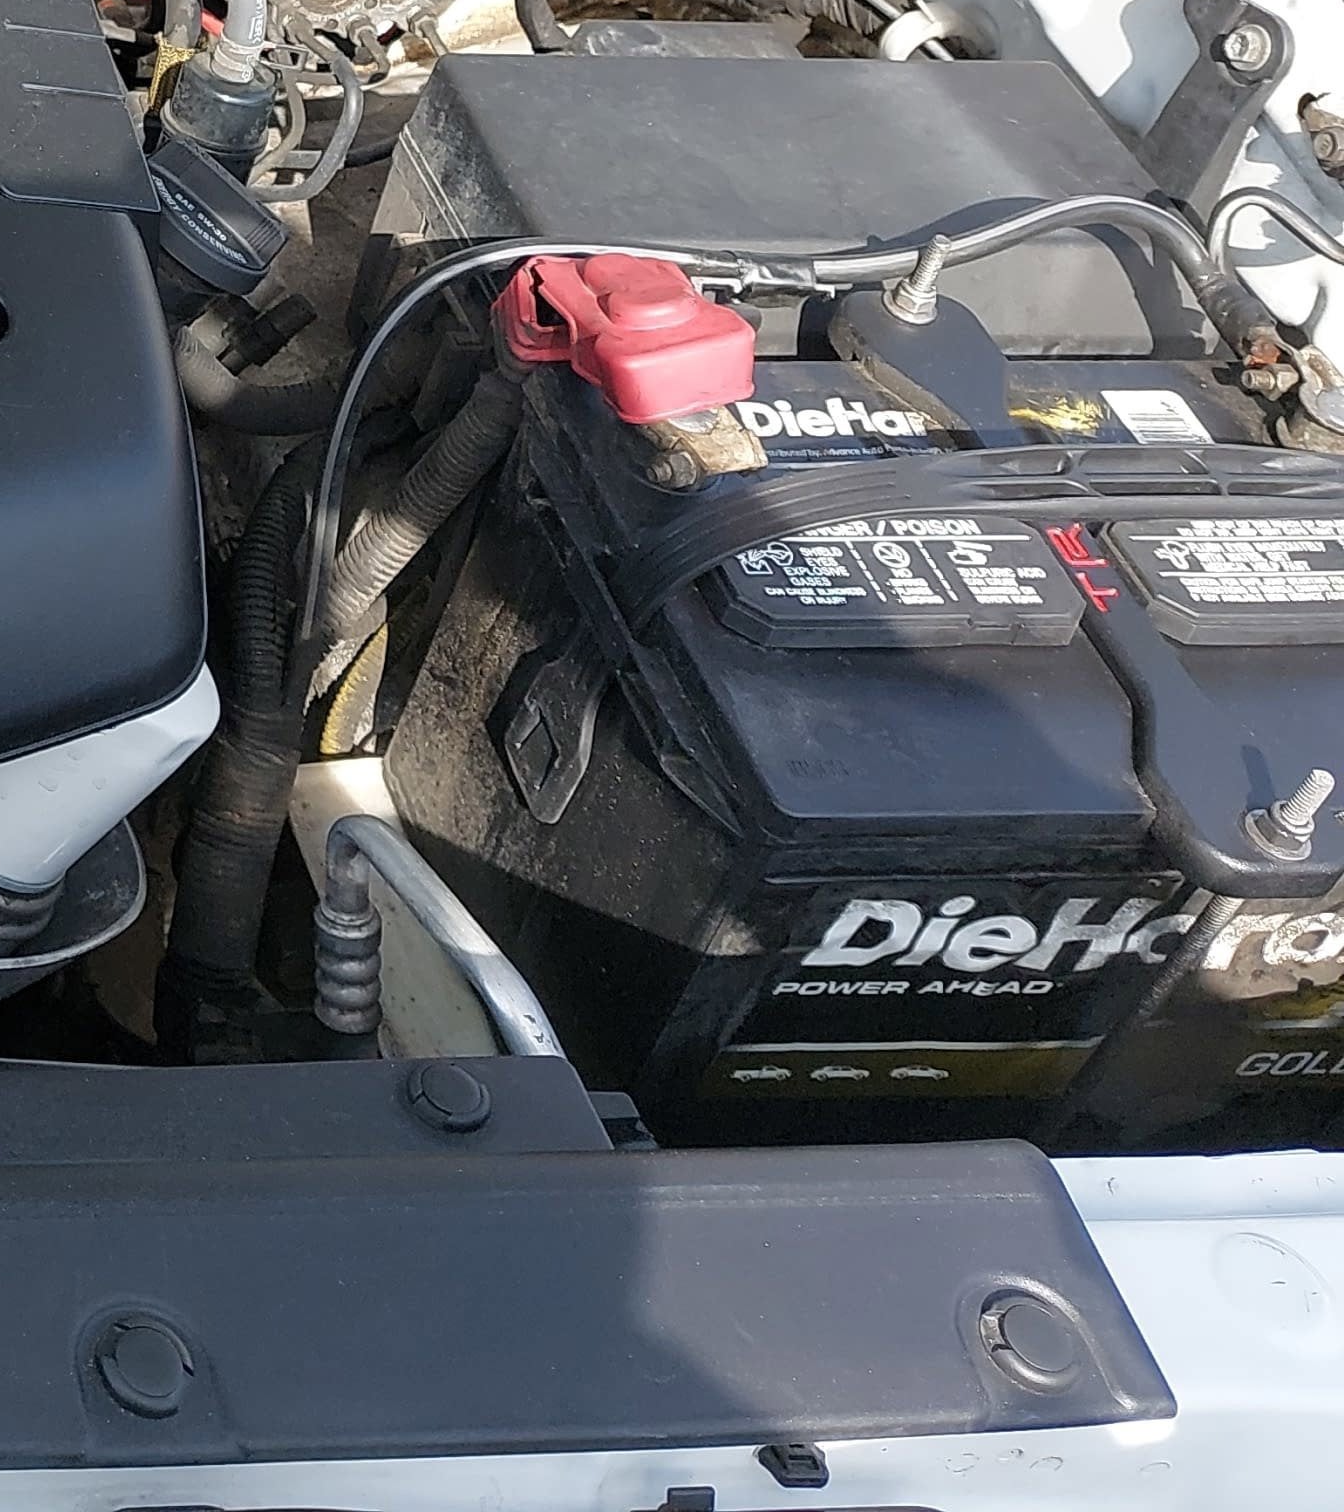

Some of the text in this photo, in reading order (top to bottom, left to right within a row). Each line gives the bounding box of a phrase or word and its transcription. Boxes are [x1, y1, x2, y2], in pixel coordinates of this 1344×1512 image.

[736, 397, 928, 437] DieHar
[892, 519, 982, 536] POISON
[799, 547, 844, 558] SHIELD
[804, 557, 840, 567] EYES
[783, 566, 851, 577] EXPLOSIVE
[790, 577, 832, 587] GASES
[772, 981, 1055, 996] POWER AHEAD
